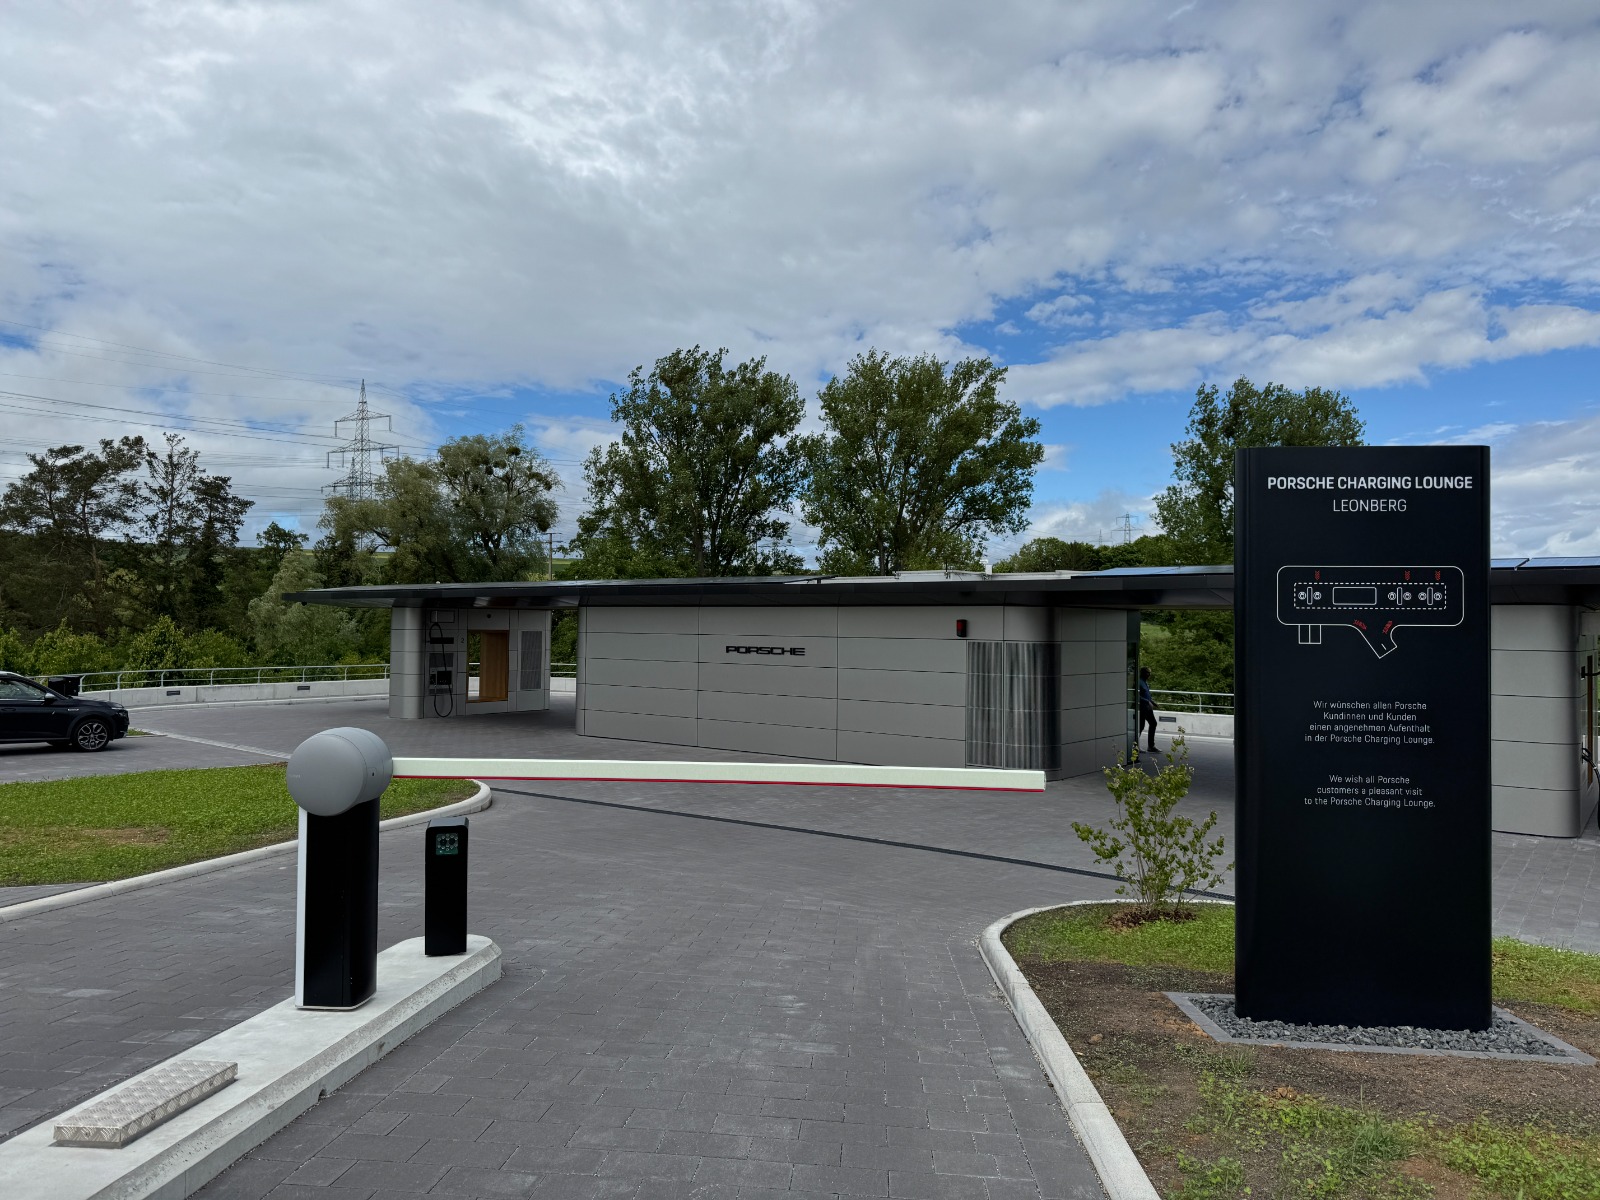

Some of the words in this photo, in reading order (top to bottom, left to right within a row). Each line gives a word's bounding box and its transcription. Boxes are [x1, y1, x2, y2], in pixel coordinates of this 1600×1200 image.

[1268, 476, 1335, 490] PORSCHE
[1338, 476, 1412, 490] CHARGING
[1415, 475, 1473, 489] LOUNGE
[1333, 499, 1407, 512] LEONBERG
[725, 645, 806, 656] PORSCHE
[1313, 700, 1328, 709] Wir
[1329, 700, 1371, 710] wünschen
[1372, 701, 1392, 710] allen
[1394, 701, 1427, 710] Porsche
[1323, 711, 1366, 720] Kundinnen
[1368, 712, 1384, 721] und
[1386, 712, 1417, 721] Kunden
[1309, 723, 1332, 731] einen
[1333, 723, 1386, 734] angenehmen
[1387, 723, 1431, 733] Aufenthalt
[1304, 733, 1313, 742] in
[1314, 733, 1328, 742] der
[1330, 733, 1362, 743] Porsche
[1364, 734, 1401, 746] Charging
[1403, 735, 1435, 746] Lounge.
[1328, 774, 1343, 783] We
[1344, 774, 1364, 784] wish
[1365, 775, 1375, 784] all
[1377, 775, 1410, 785] Porsche
[1316, 786, 1359, 795] customers
[1368, 786, 1404, 797] pleasant
[1405, 787, 1423, 796] visit
[1304, 797, 1313, 805] to
[1314, 796, 1328, 806] the
[1330, 796, 1363, 806] Porsche
[1364, 797, 1401, 809] Charging
[1403, 798, 1436, 810] Lounge.
